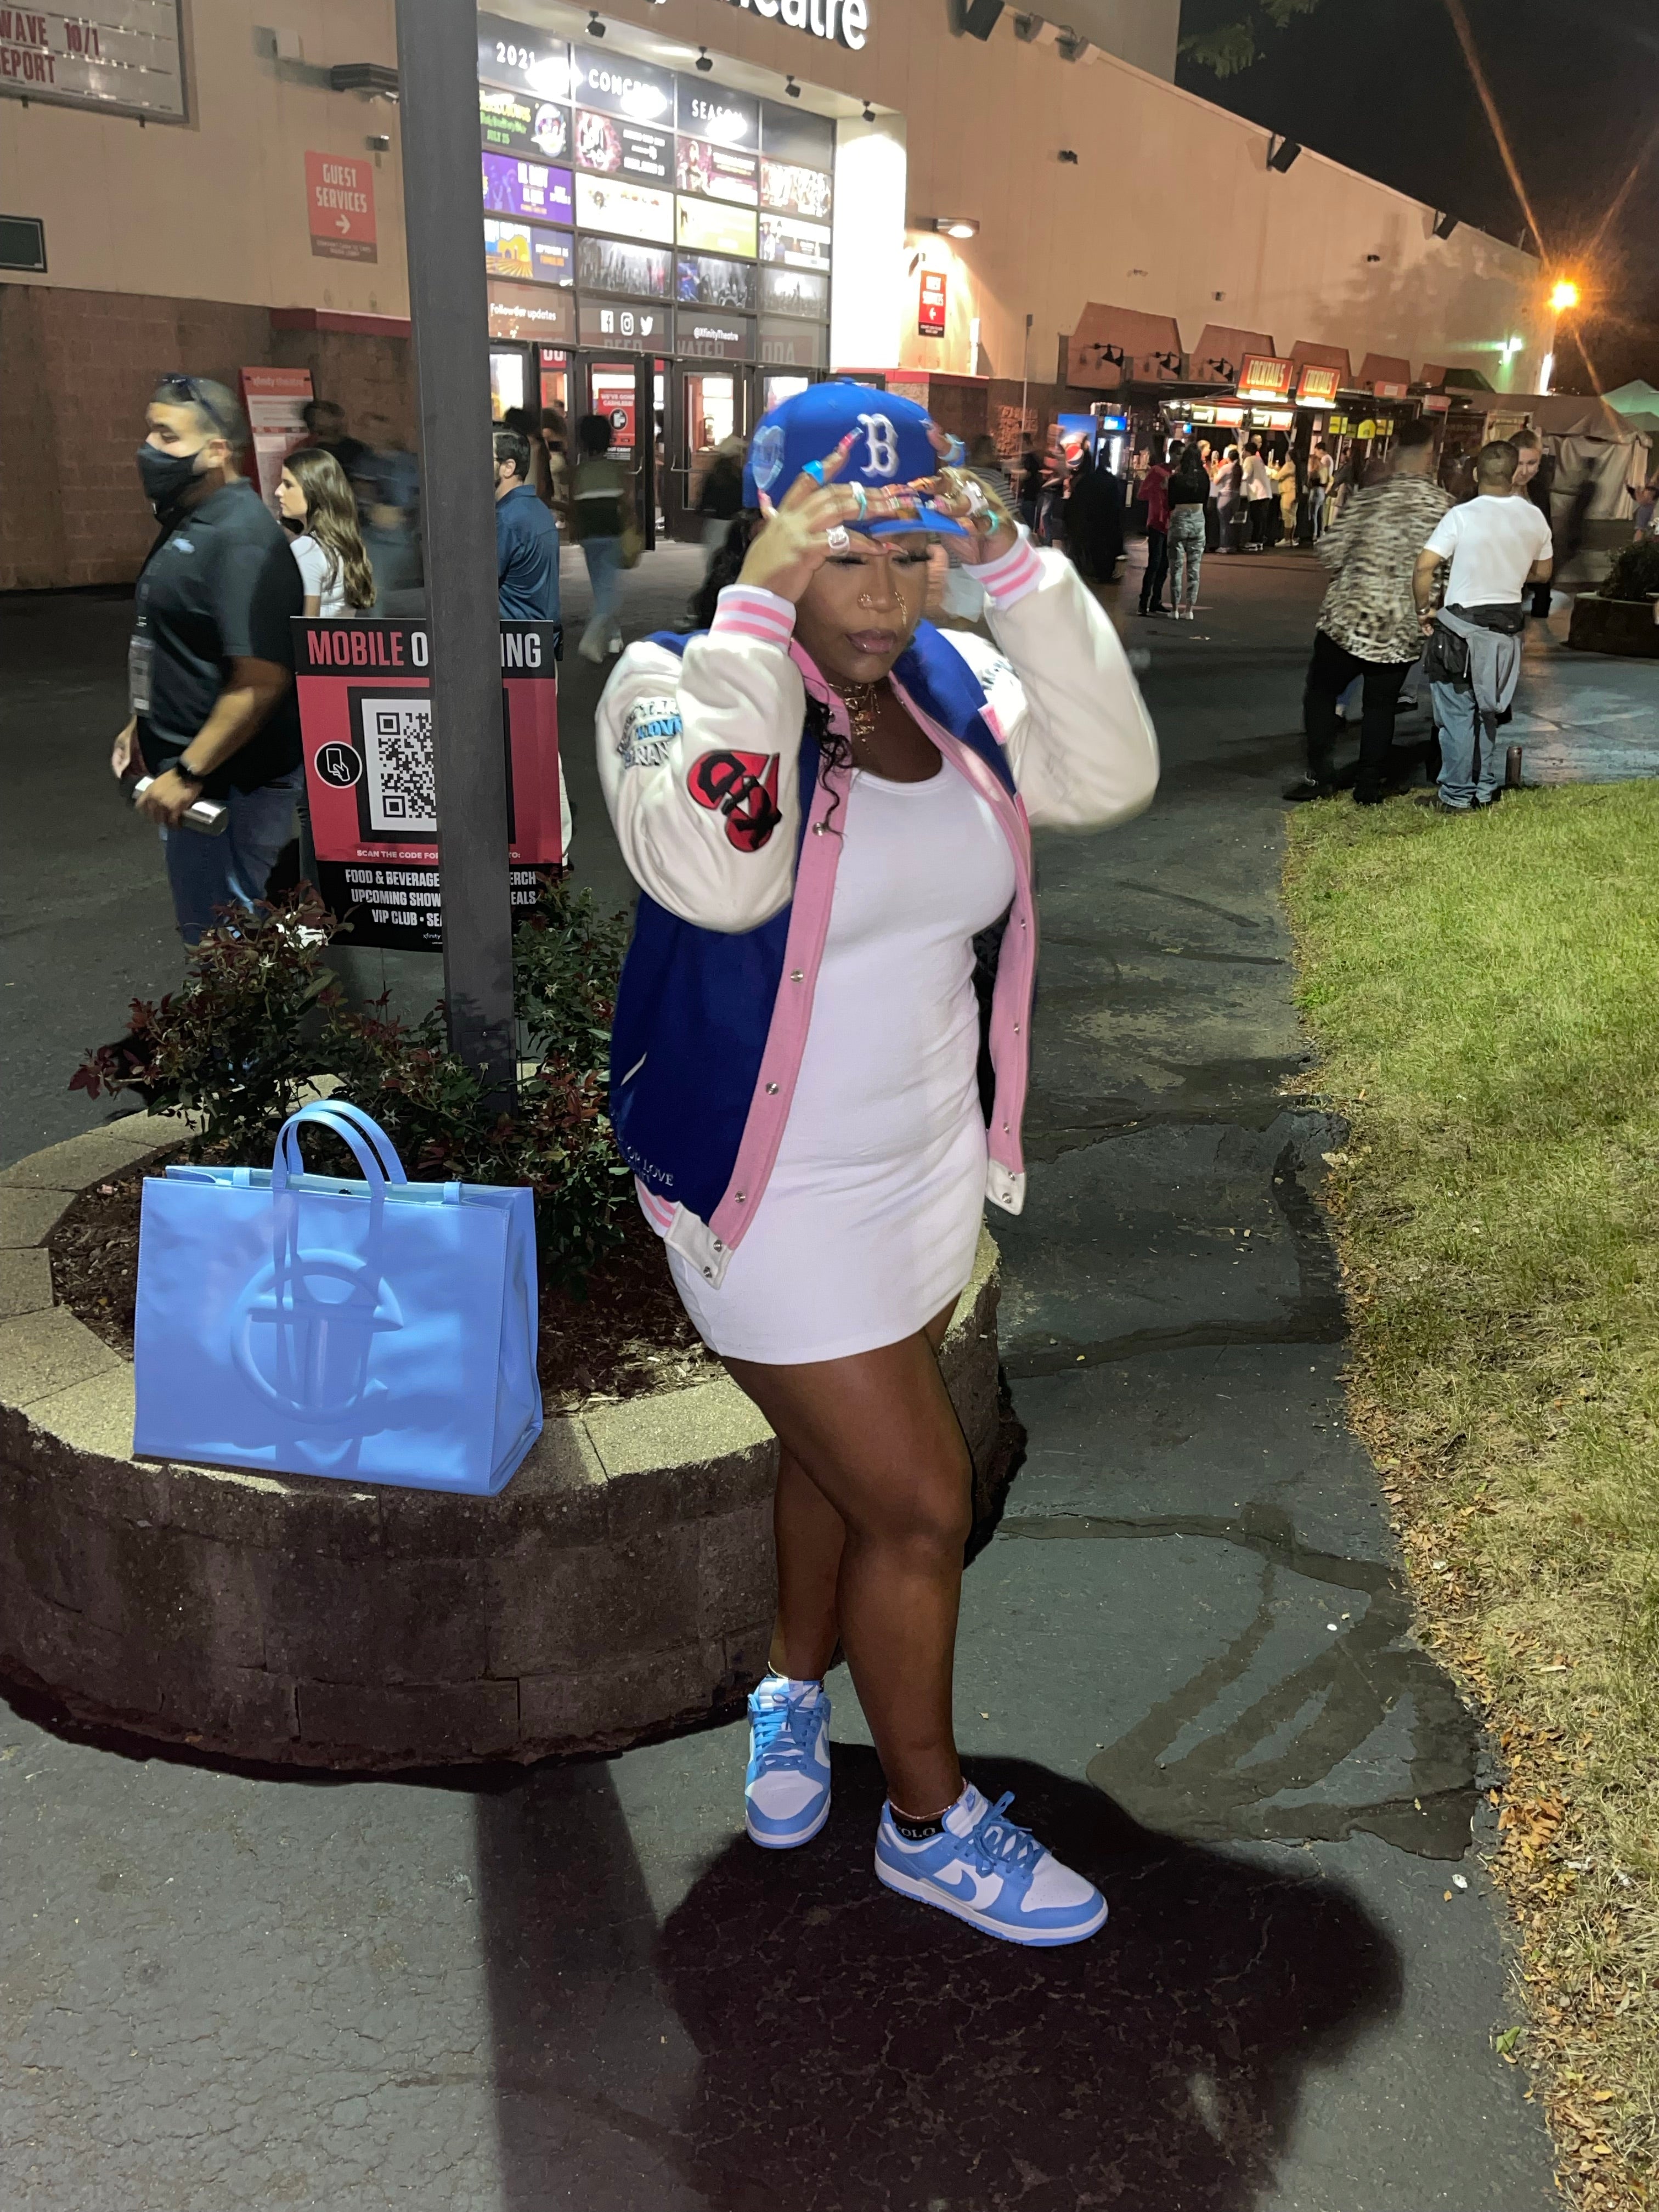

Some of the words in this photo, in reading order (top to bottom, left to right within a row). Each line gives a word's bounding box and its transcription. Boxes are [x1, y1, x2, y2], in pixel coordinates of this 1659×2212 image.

[64, 21, 100, 58] 10/1
[496, 42, 535, 70] 2021
[323, 163, 357, 188] GUEST
[315, 186, 368, 213] SERVICES
[527, 308, 556, 321] updates
[1246, 359, 1285, 387] COCKTAILS
[857, 413, 900, 478] B
[307, 630, 404, 666] MOBILE
[357, 850, 379, 858] SCAN
[345, 868, 373, 884] FOOD
[375, 870, 385, 885] &
[510, 871, 536, 885] ERCH
[351, 888, 407, 906] UPCOMING
[511, 890, 537, 905] EALS
[371, 909, 389, 923] VIP
[391, 910, 417, 926] CLUB
